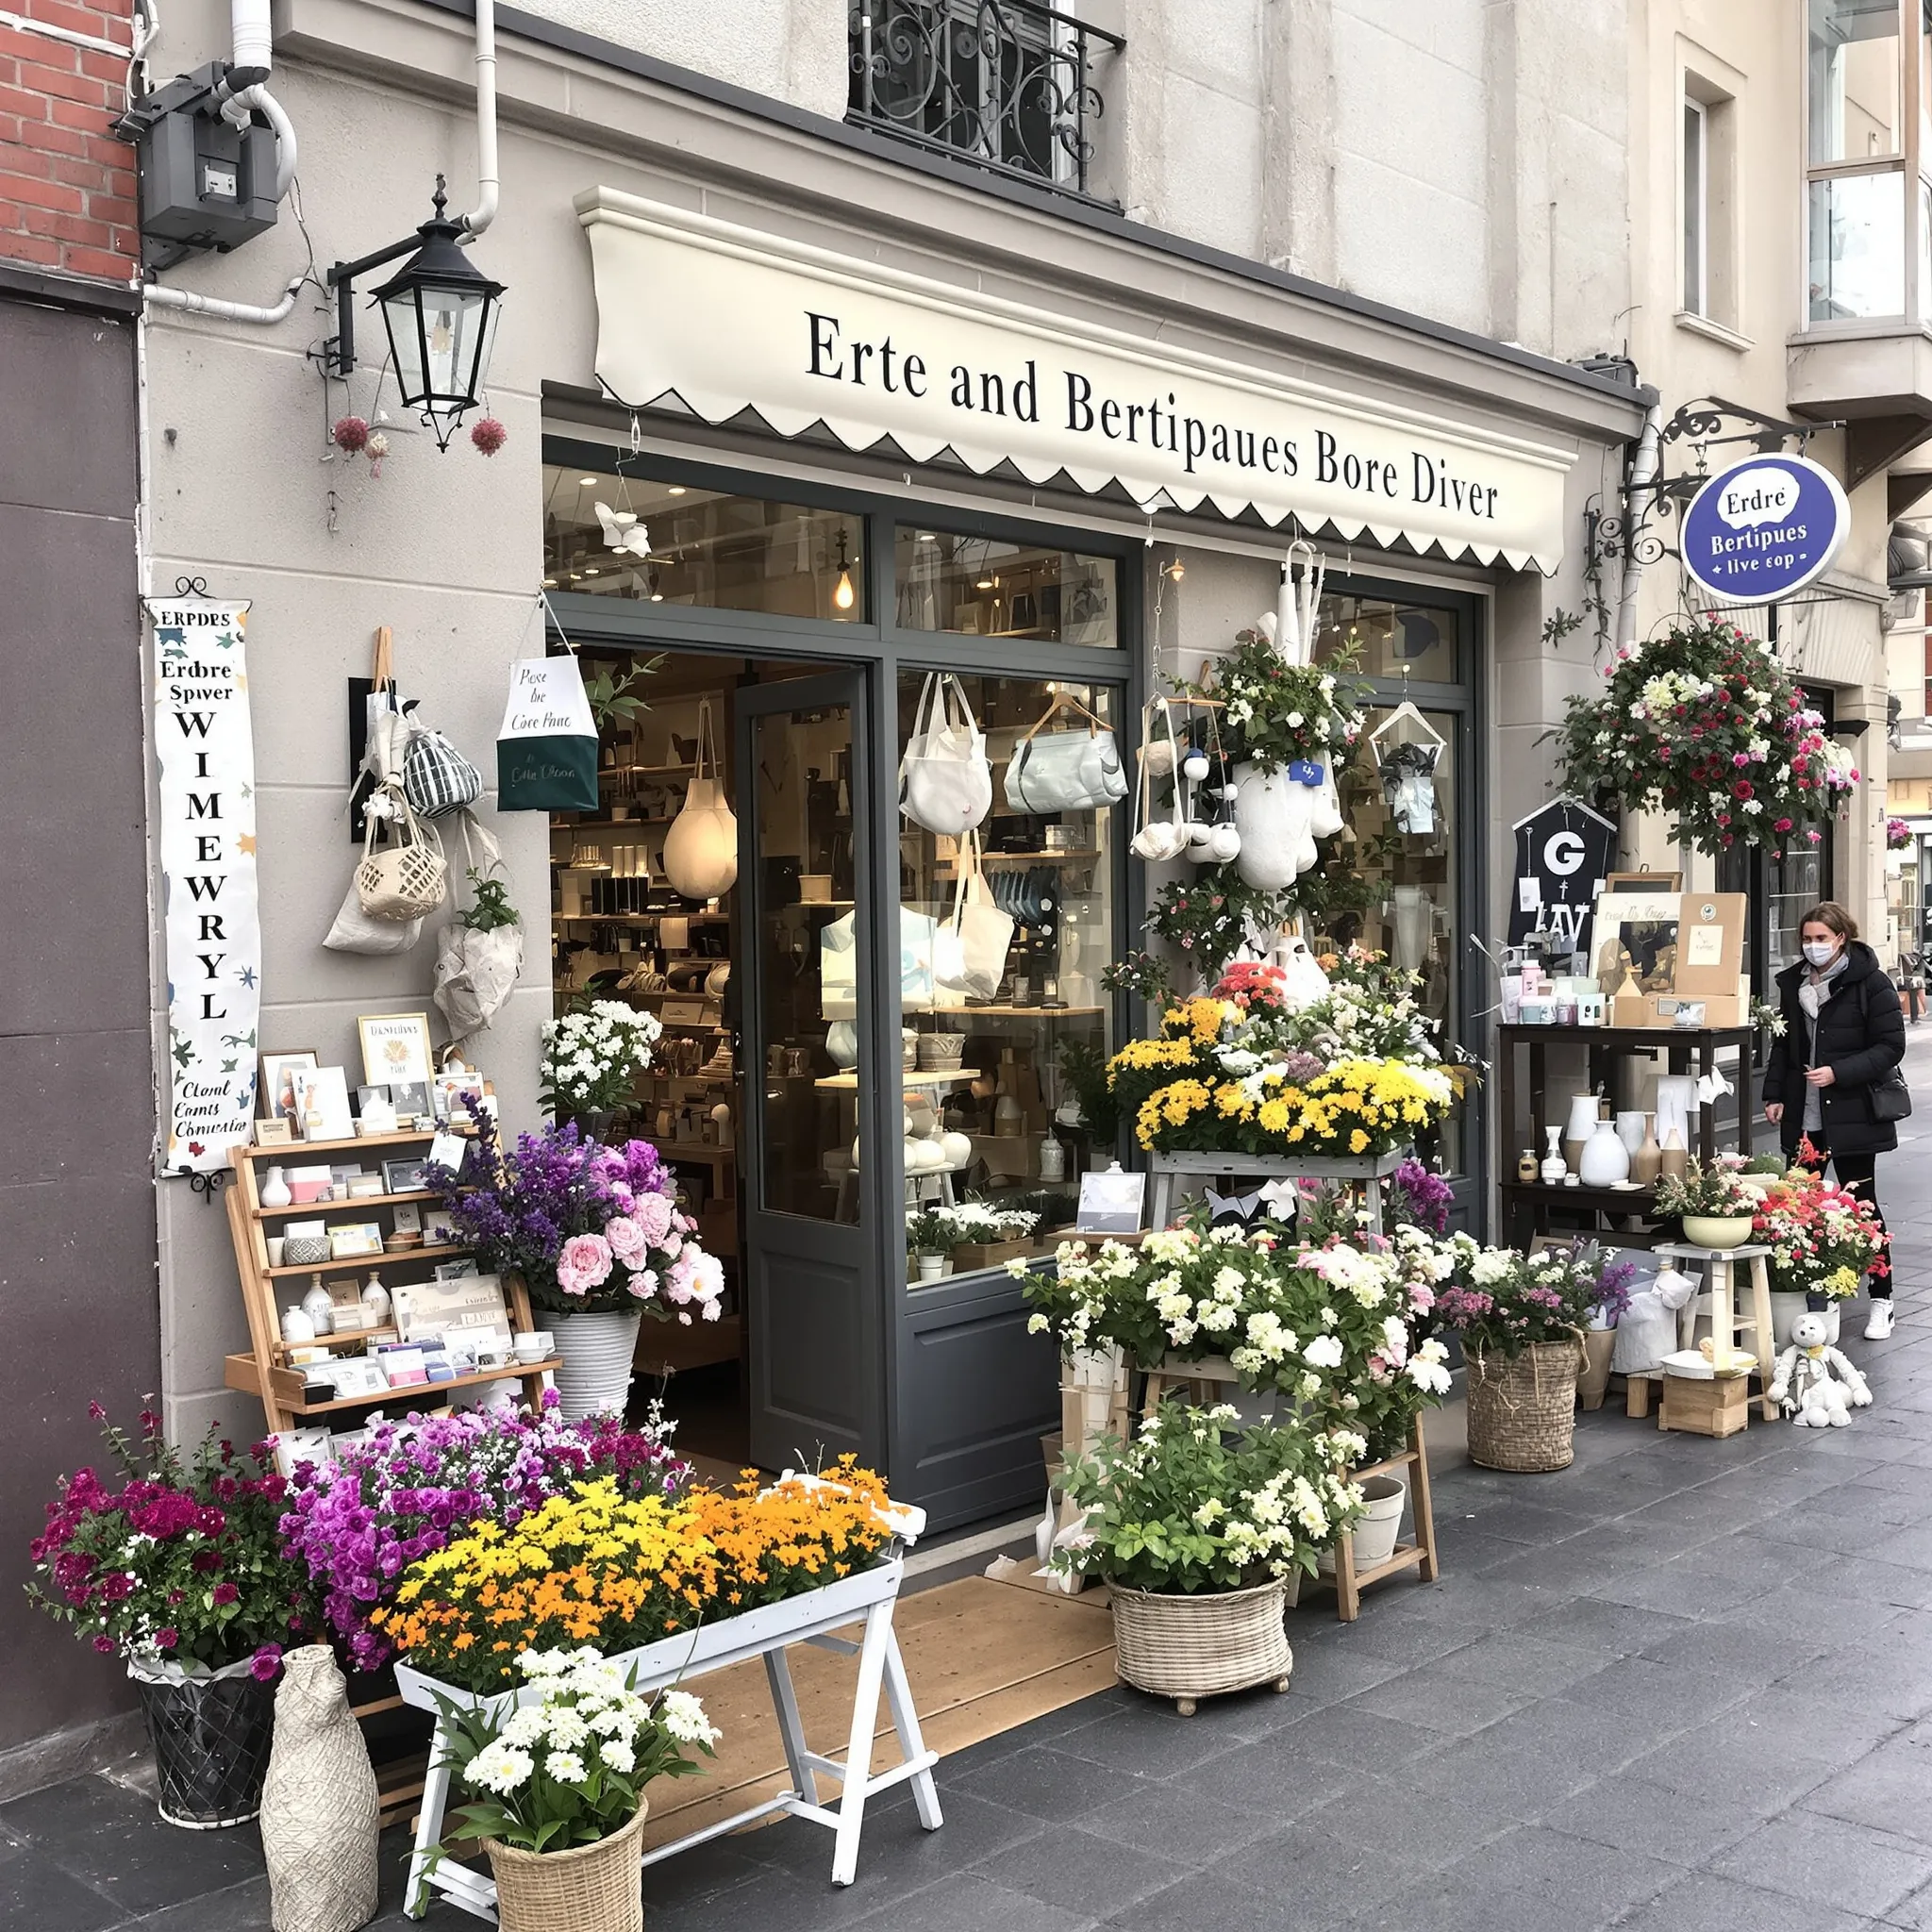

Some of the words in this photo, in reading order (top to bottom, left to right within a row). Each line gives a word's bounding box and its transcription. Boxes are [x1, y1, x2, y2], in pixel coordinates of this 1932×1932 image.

[804, 310, 927, 398] Erte
[950, 360, 1041, 423] and
[1063, 371, 1299, 477] Bertipaues
[1314, 429, 1399, 499] Bore
[1410, 451, 1499, 520] Diver
[1710, 524, 1807, 556] Bertipues
[1543, 831, 1586, 875] G
